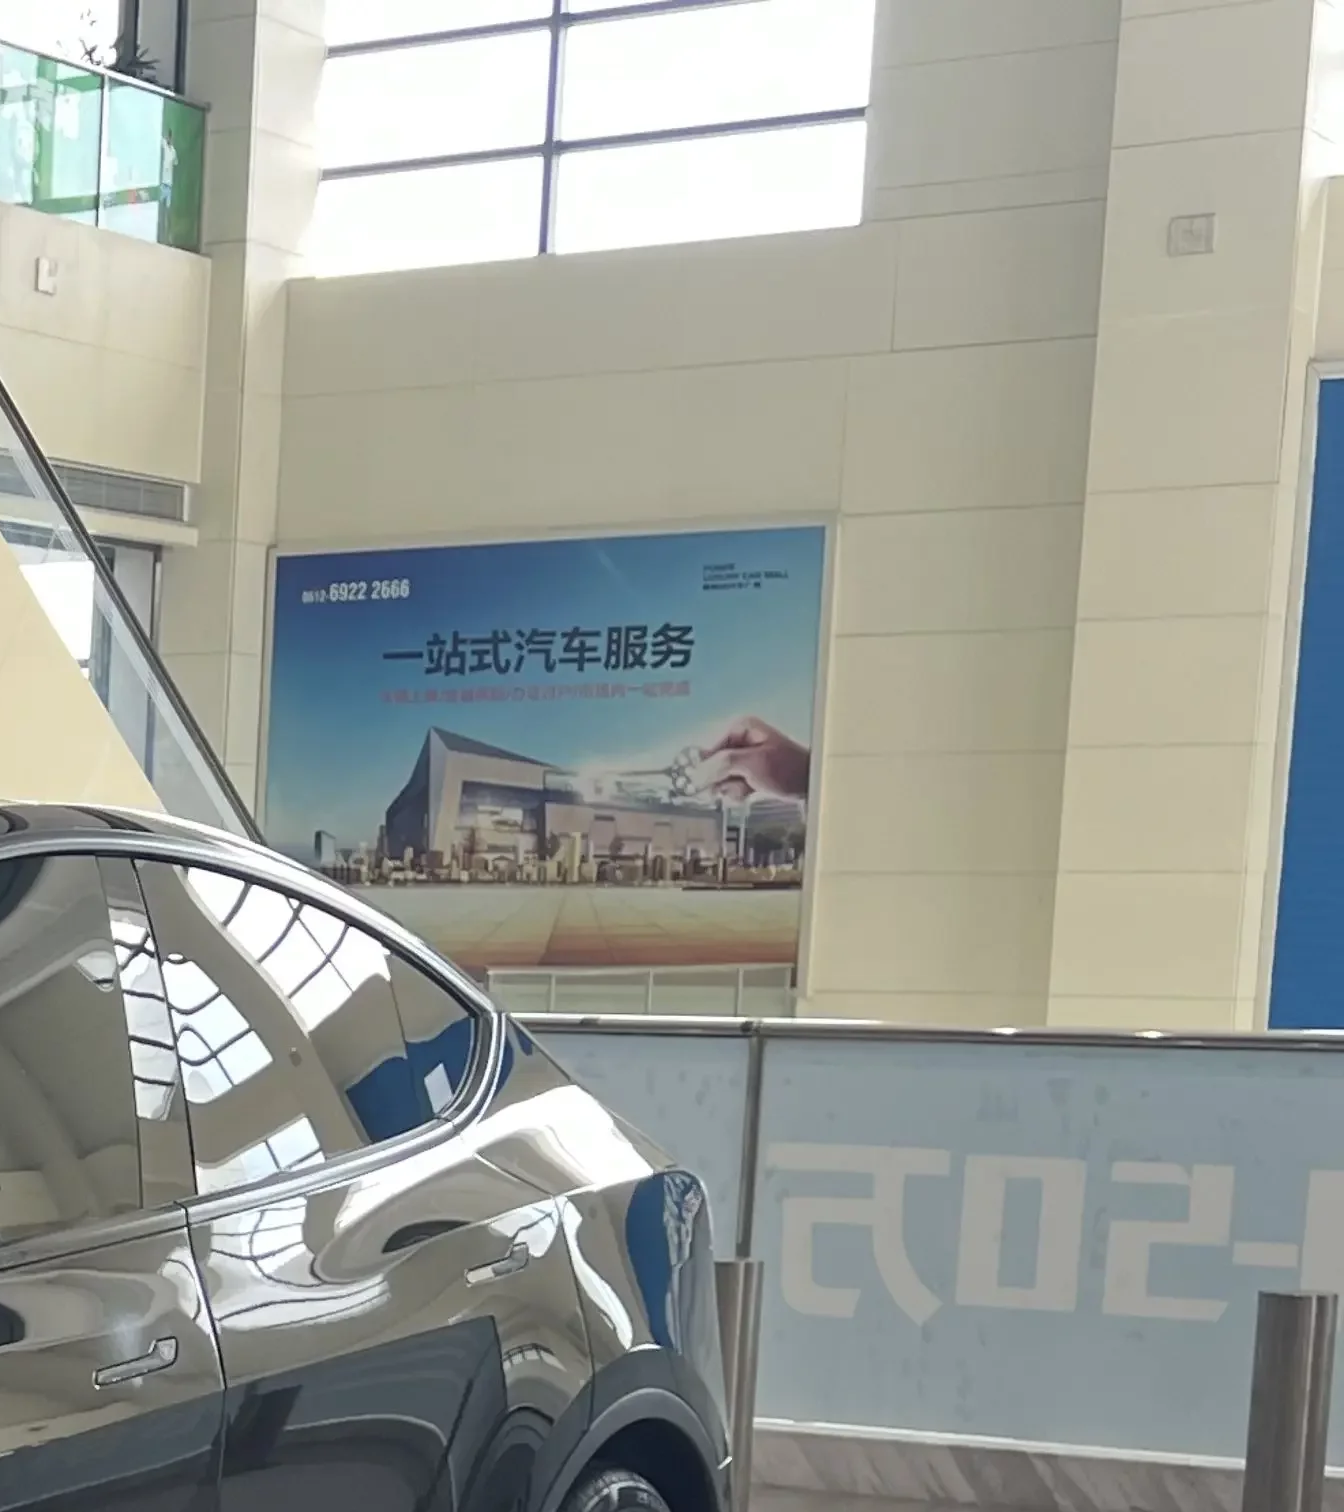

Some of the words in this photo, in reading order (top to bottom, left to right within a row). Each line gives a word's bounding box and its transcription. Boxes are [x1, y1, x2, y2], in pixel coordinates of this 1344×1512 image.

[382, 622, 694, 676] 一站式汽车服务
